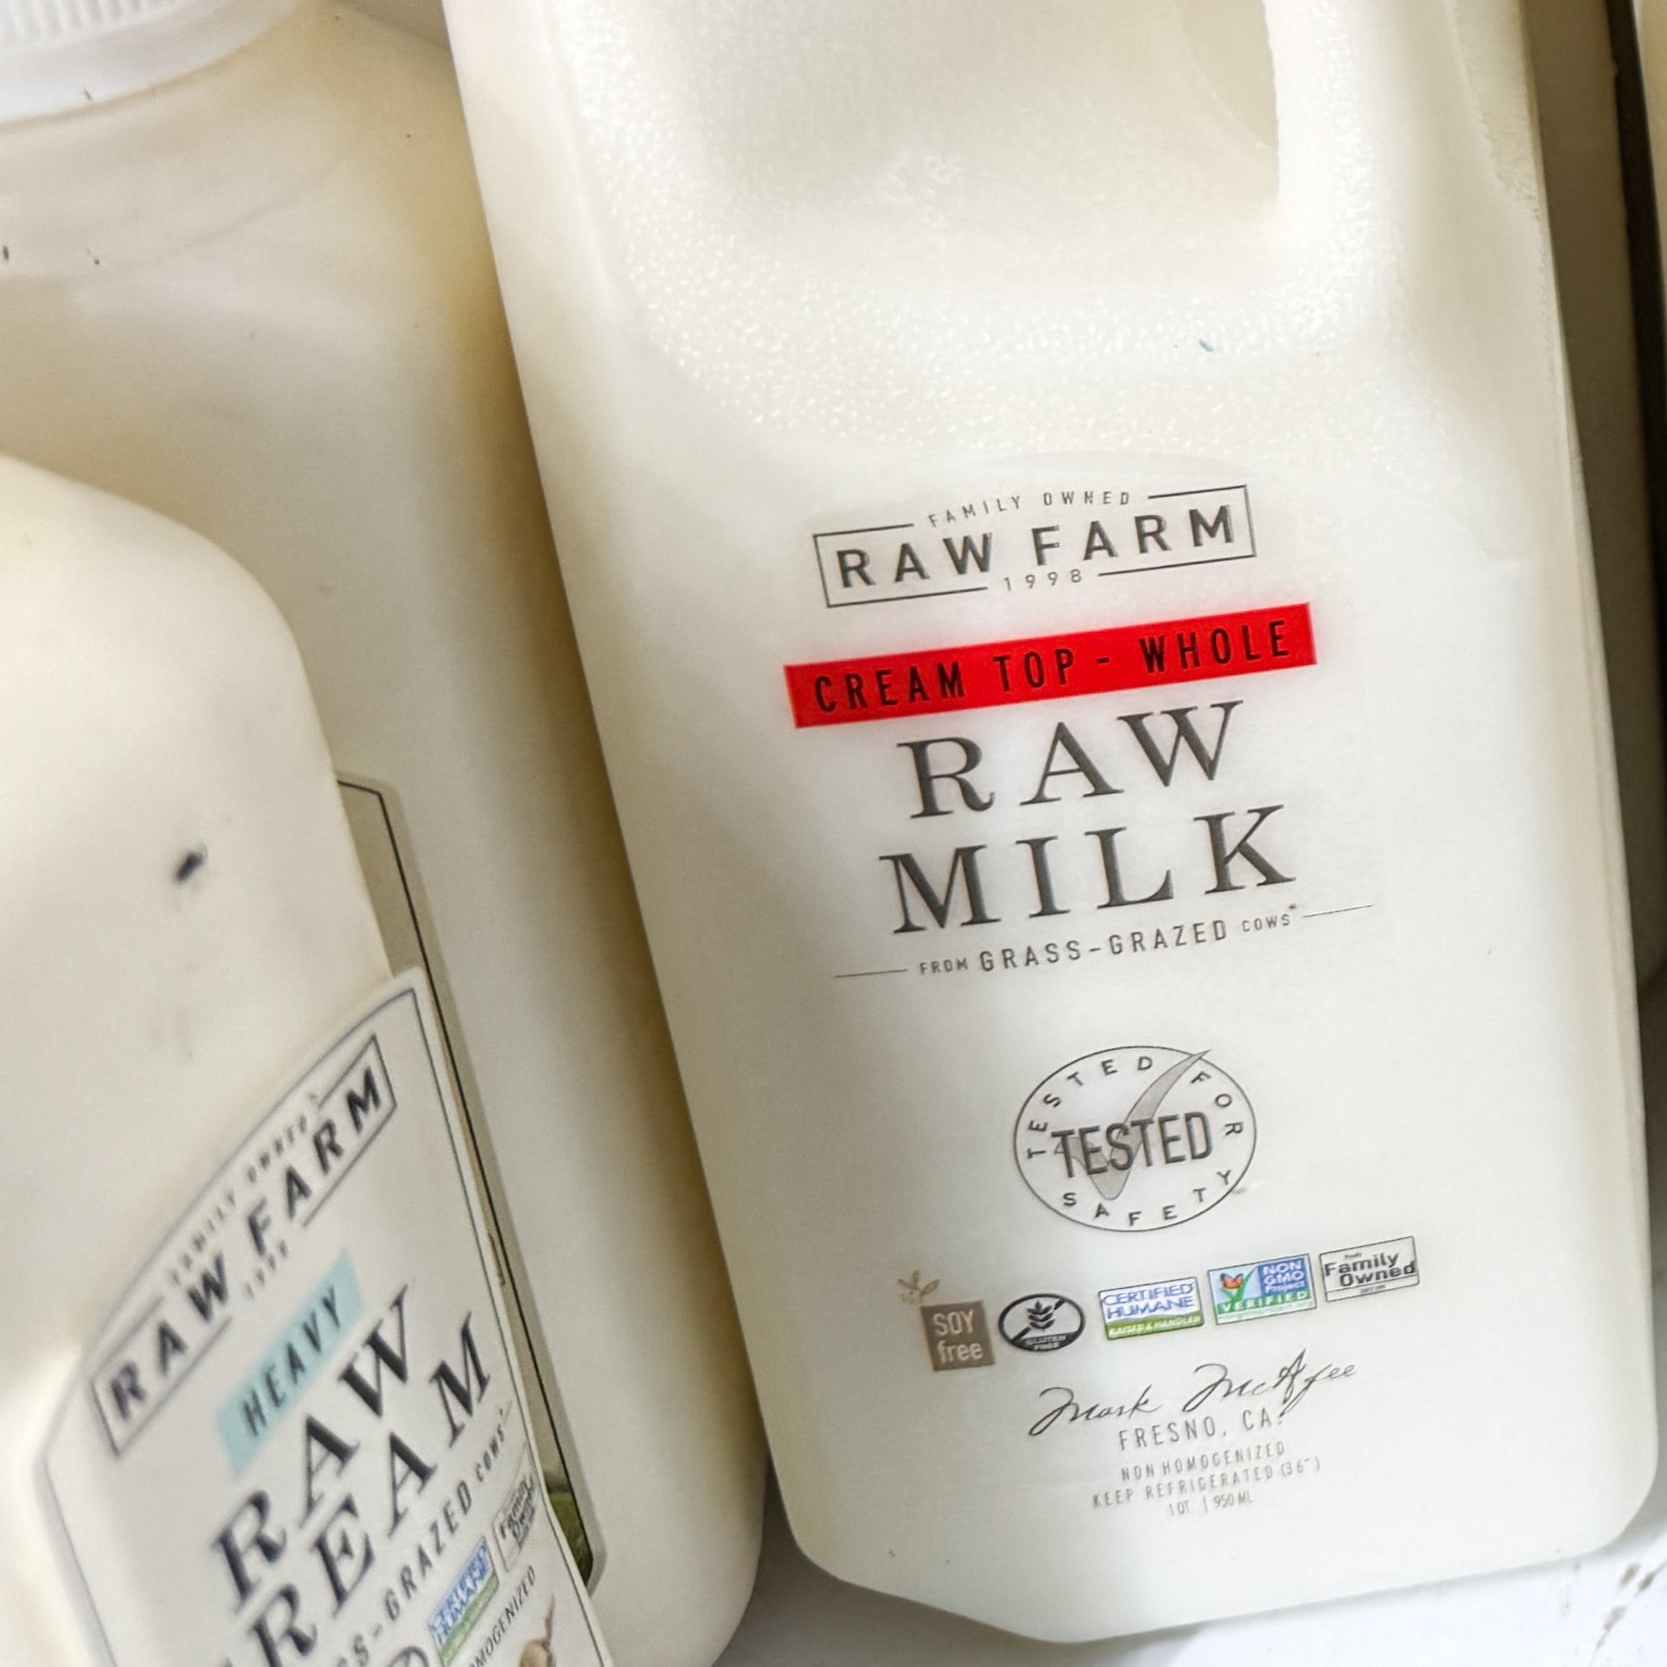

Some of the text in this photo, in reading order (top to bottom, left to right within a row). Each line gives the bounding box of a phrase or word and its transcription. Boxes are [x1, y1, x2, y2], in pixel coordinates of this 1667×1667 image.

[928, 490, 1132, 529] FAMILY OWNED
[836, 503, 1237, 589] RAW FARM
[1002, 566, 1083, 592] 1998
[813, 618, 1291, 714] CREAM TOP WHOLE
[896, 700, 1245, 820] RAW
[878, 803, 1297, 935] MILK
[919, 958, 969, 976] FROM
[979, 918, 1228, 974] GRASS-GRAZED
[1026, 1055, 1154, 1161] TESTED
[1050, 1111, 1214, 1179] TESTED
[1062, 1169, 1233, 1227] SAFETY
[108, 1066, 382, 1422] RAW FARM
[1324, 1251, 1400, 1277] Family
[1262, 1260, 1304, 1277] NON
[1262, 1269, 1306, 1287] GMO
[1339, 1260, 1417, 1288] Owned
[1101, 1282, 1196, 1307] CERTIFIED
[1106, 1296, 1196, 1321] HUMANE
[1220, 1291, 1310, 1314] VERIFIED
[932, 1309, 976, 1337] SOY
[241, 1285, 341, 1438] HEAVY
[936, 1339, 984, 1365] free
[211, 1282, 412, 1616] RAW
[1120, 1440, 1286, 1482] NON HOMOGENIZED
[1092, 1487, 1135, 1510] KEEP
[1145, 1464, 1275, 1502] REFRIGERATED
